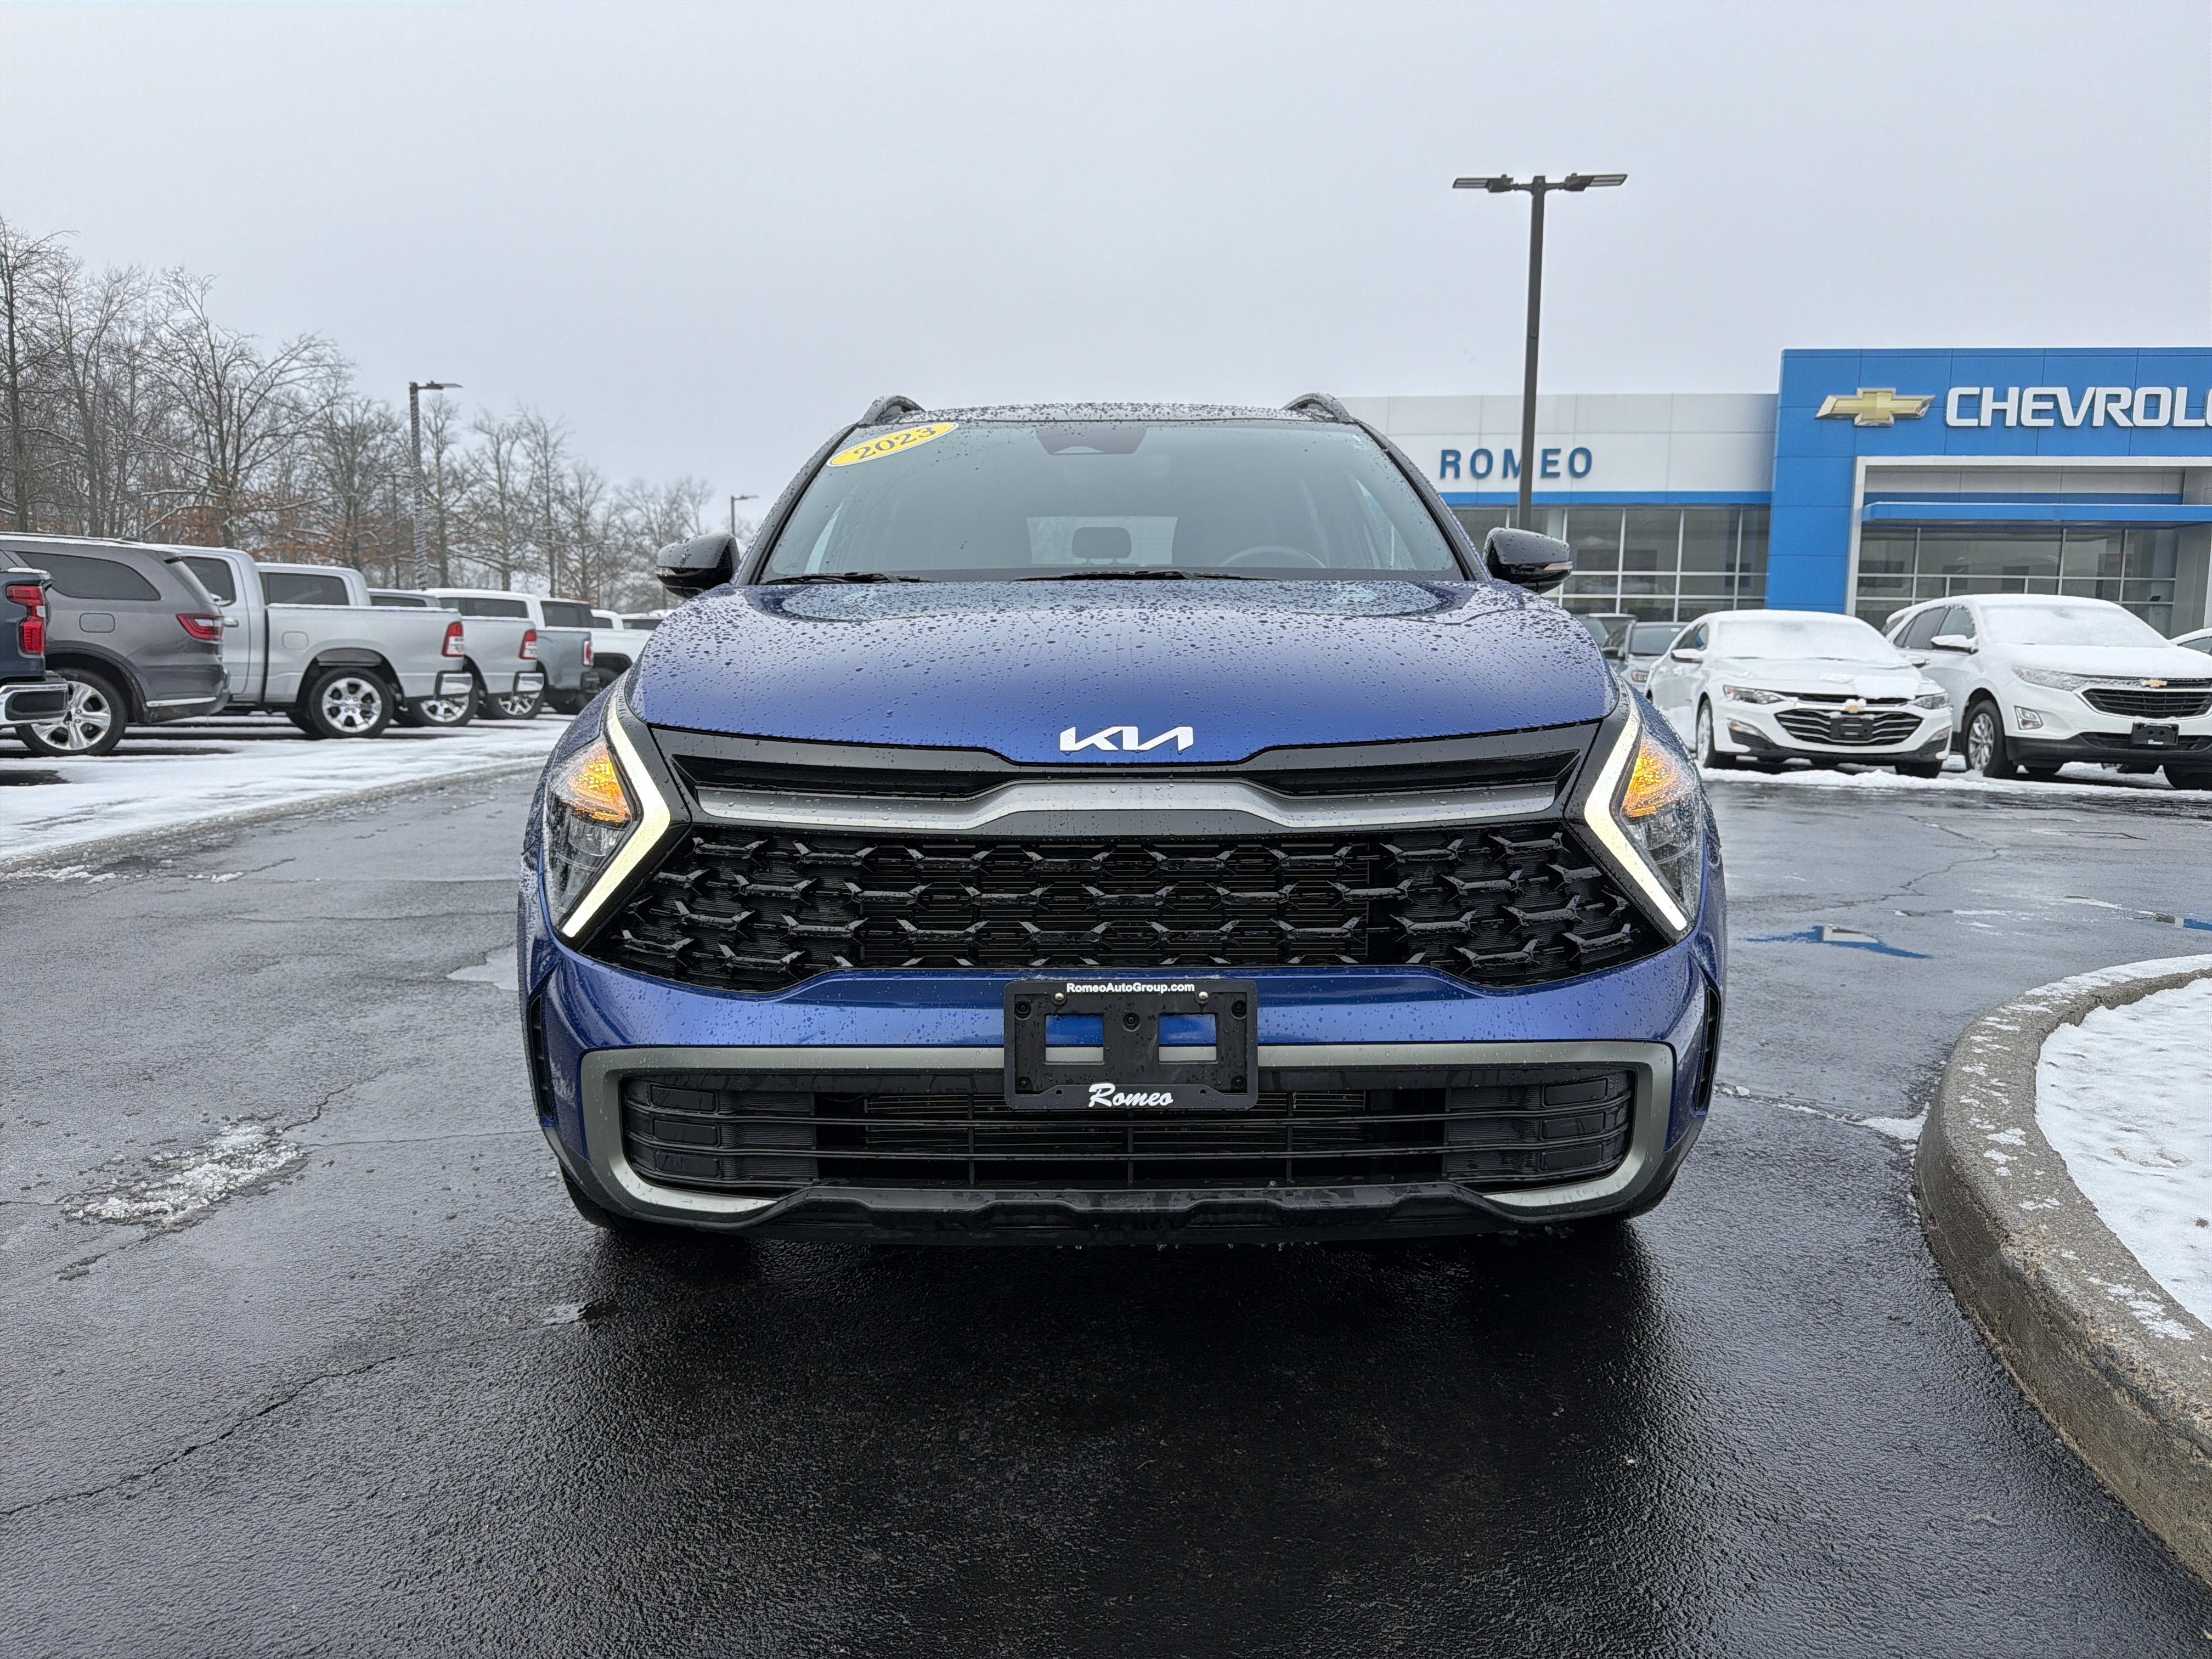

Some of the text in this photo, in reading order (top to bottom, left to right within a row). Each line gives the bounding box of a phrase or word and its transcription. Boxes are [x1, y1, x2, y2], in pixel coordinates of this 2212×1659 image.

[1946, 387, 2212, 427] CHEVROL
[854, 427, 936, 460] 2023
[1440, 447, 1592, 479] ROMEO
[1060, 726, 1194, 751] KIA
[1066, 983, 1195, 994] RomeoAutoGroup.com
[1088, 1082, 1173, 1107] Romeo
